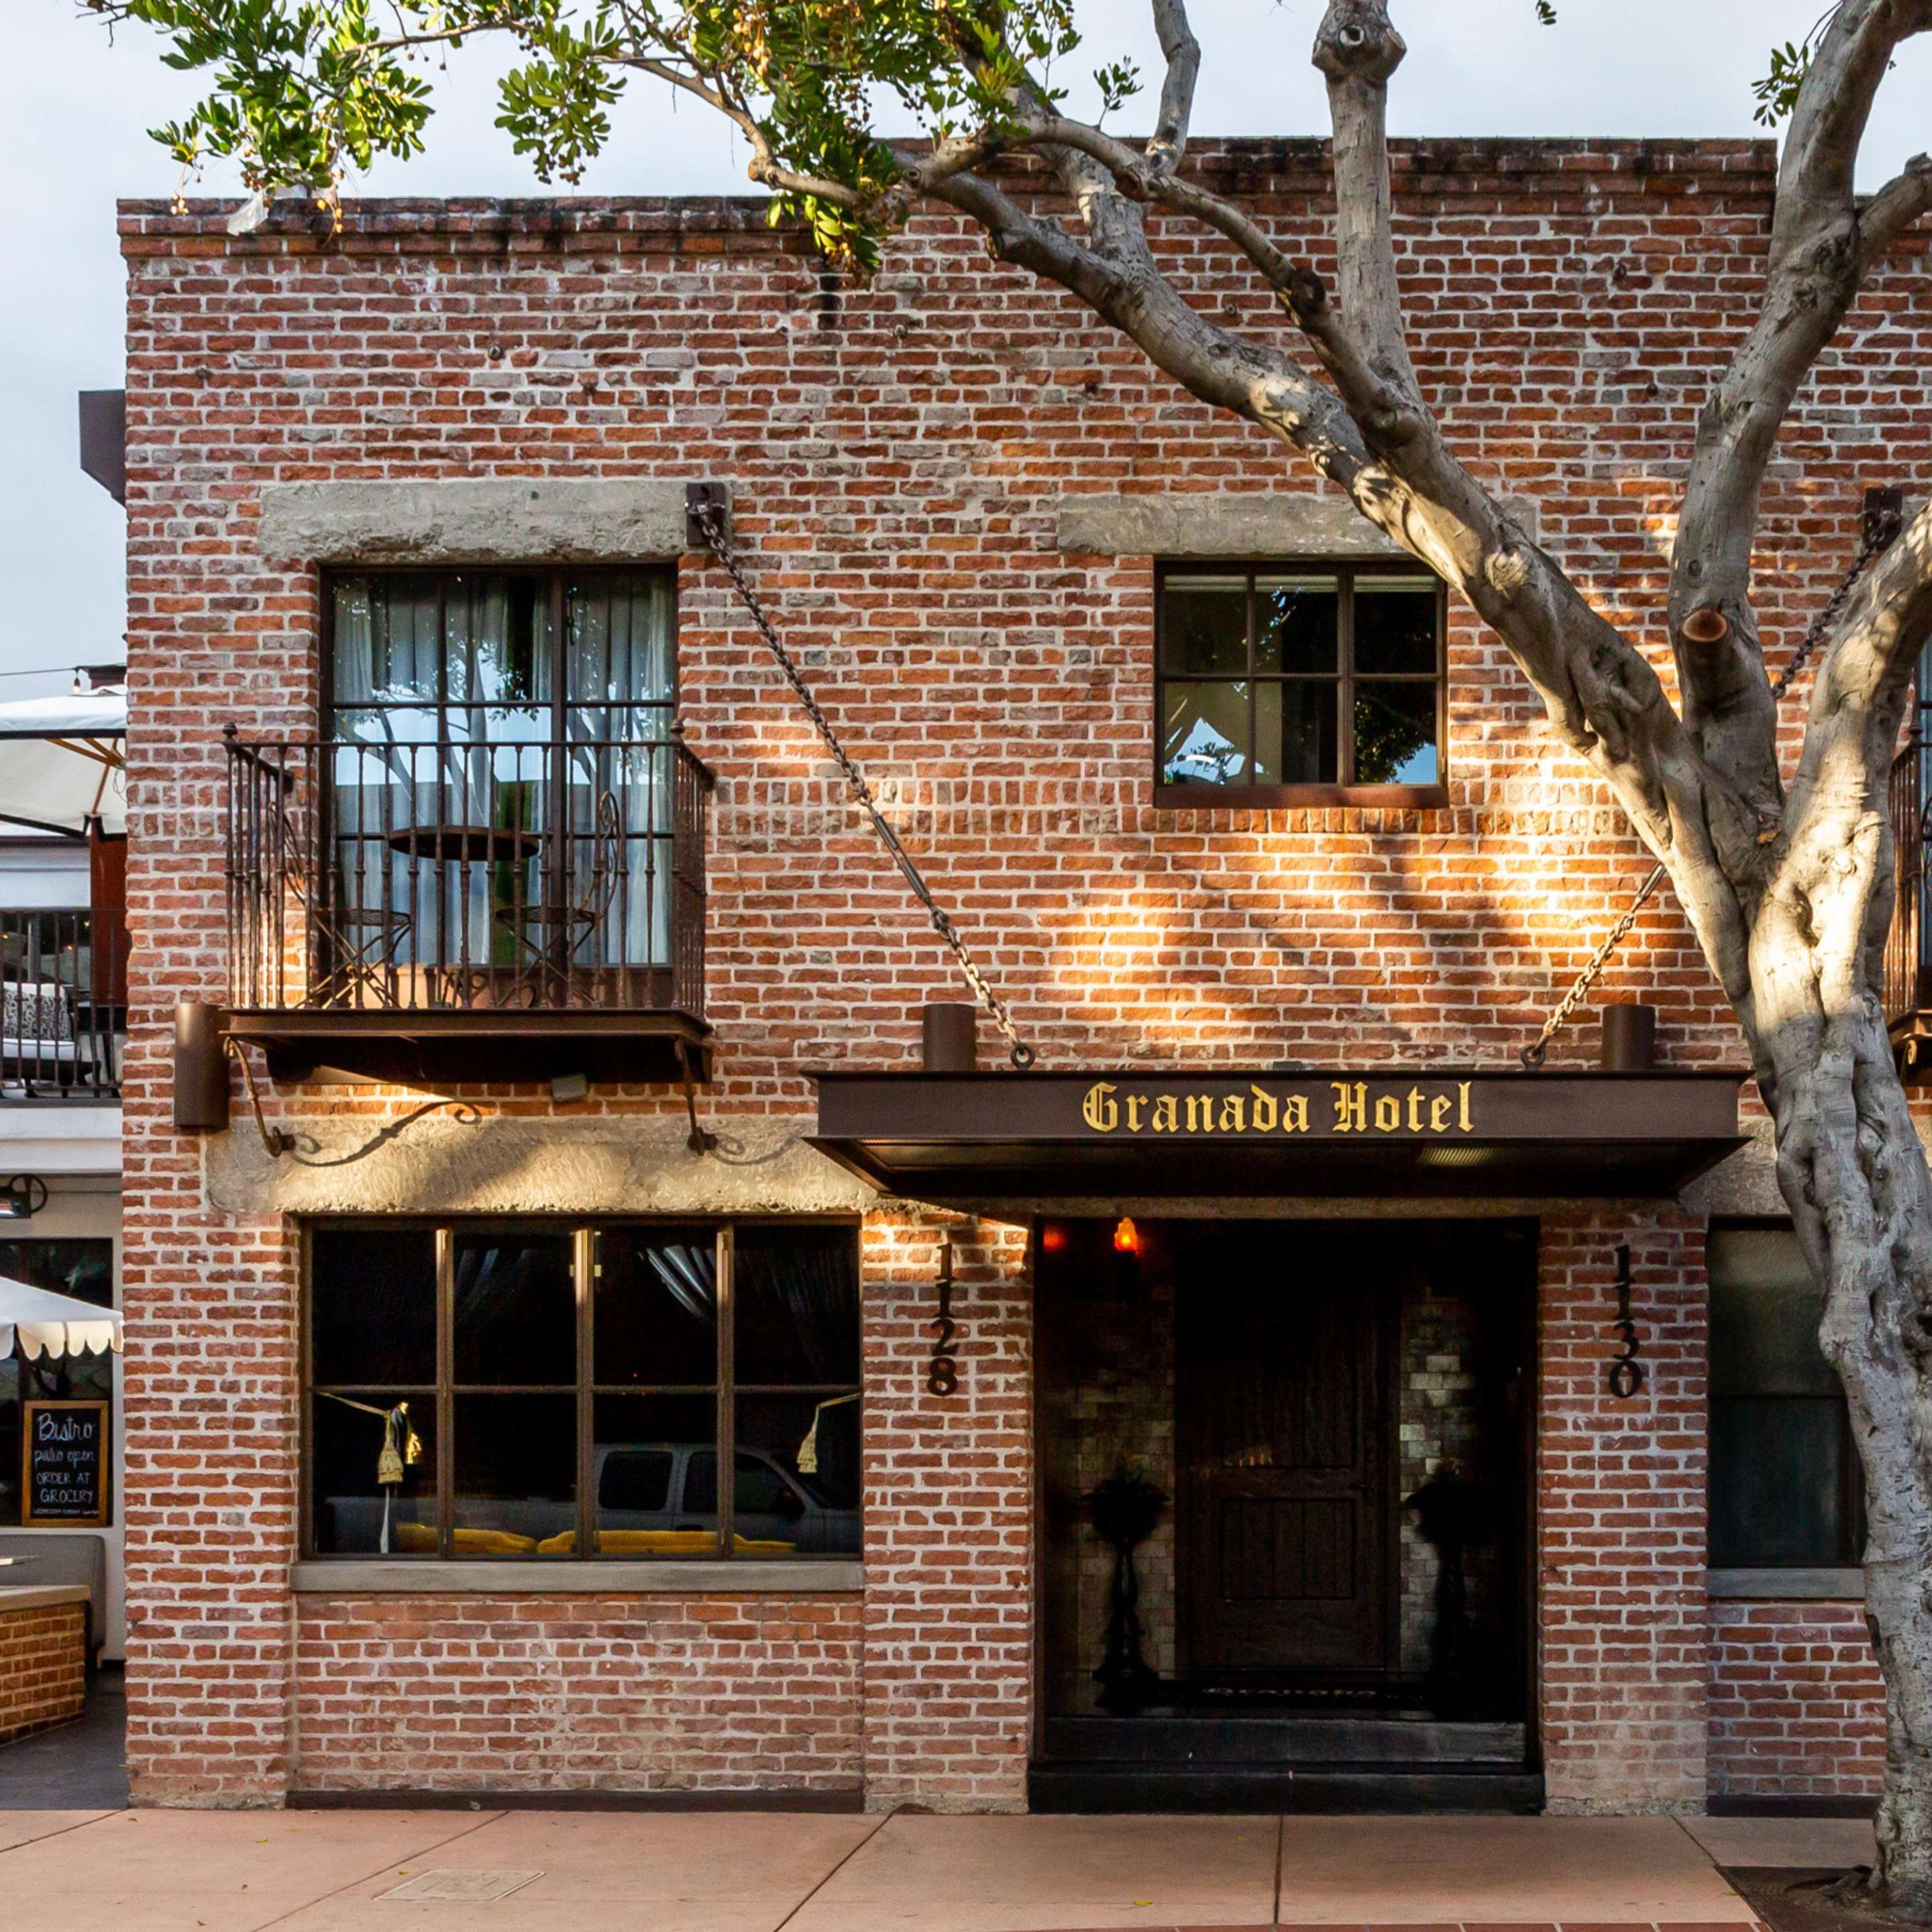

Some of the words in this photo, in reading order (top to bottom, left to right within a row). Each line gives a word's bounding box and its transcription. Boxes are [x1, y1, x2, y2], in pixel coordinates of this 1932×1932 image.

[1083, 1081, 1310, 1132] Granada
[1331, 1081, 1475, 1132] Hotel
[927, 1242, 958, 1396] 1128
[1609, 1244, 1644, 1398] 1130
[38, 1412, 95, 1440] Bistro
[34, 1447, 63, 1470] patio
[67, 1450, 95, 1468] open
[36, 1472, 72, 1484] ORDER
[77, 1472, 90, 1484] AT
[40, 1487, 93, 1503] GROCERY
